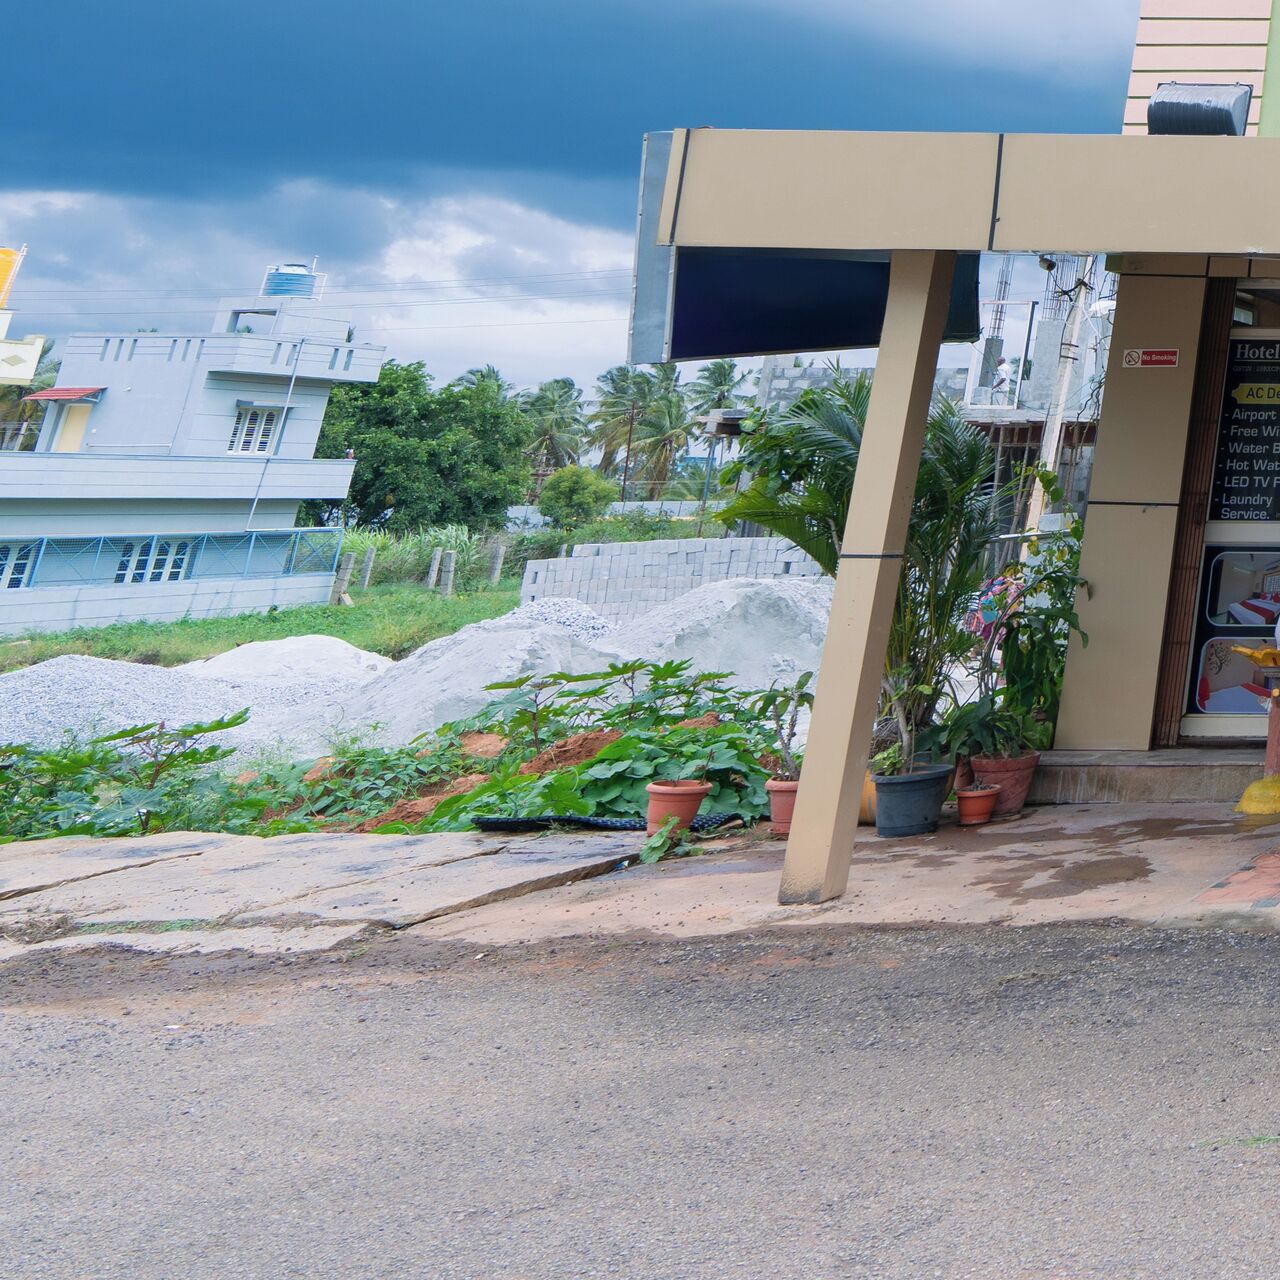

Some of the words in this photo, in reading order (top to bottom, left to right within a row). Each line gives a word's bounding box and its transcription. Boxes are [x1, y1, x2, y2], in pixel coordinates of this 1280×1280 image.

[1236, 344, 1279, 360] Hotel
[1246, 389, 1264, 399] AC
[1232, 408, 1277, 422] Airport
[1230, 425, 1258, 437] Free
[1228, 442, 1269, 454] Water
[1226, 459, 1250, 471] Hot
[1224, 476, 1250, 488] LED
[1253, 476, 1270, 488] TV
[1222, 493, 1273, 508] Laundry
[1220, 508, 1270, 520] Service.
